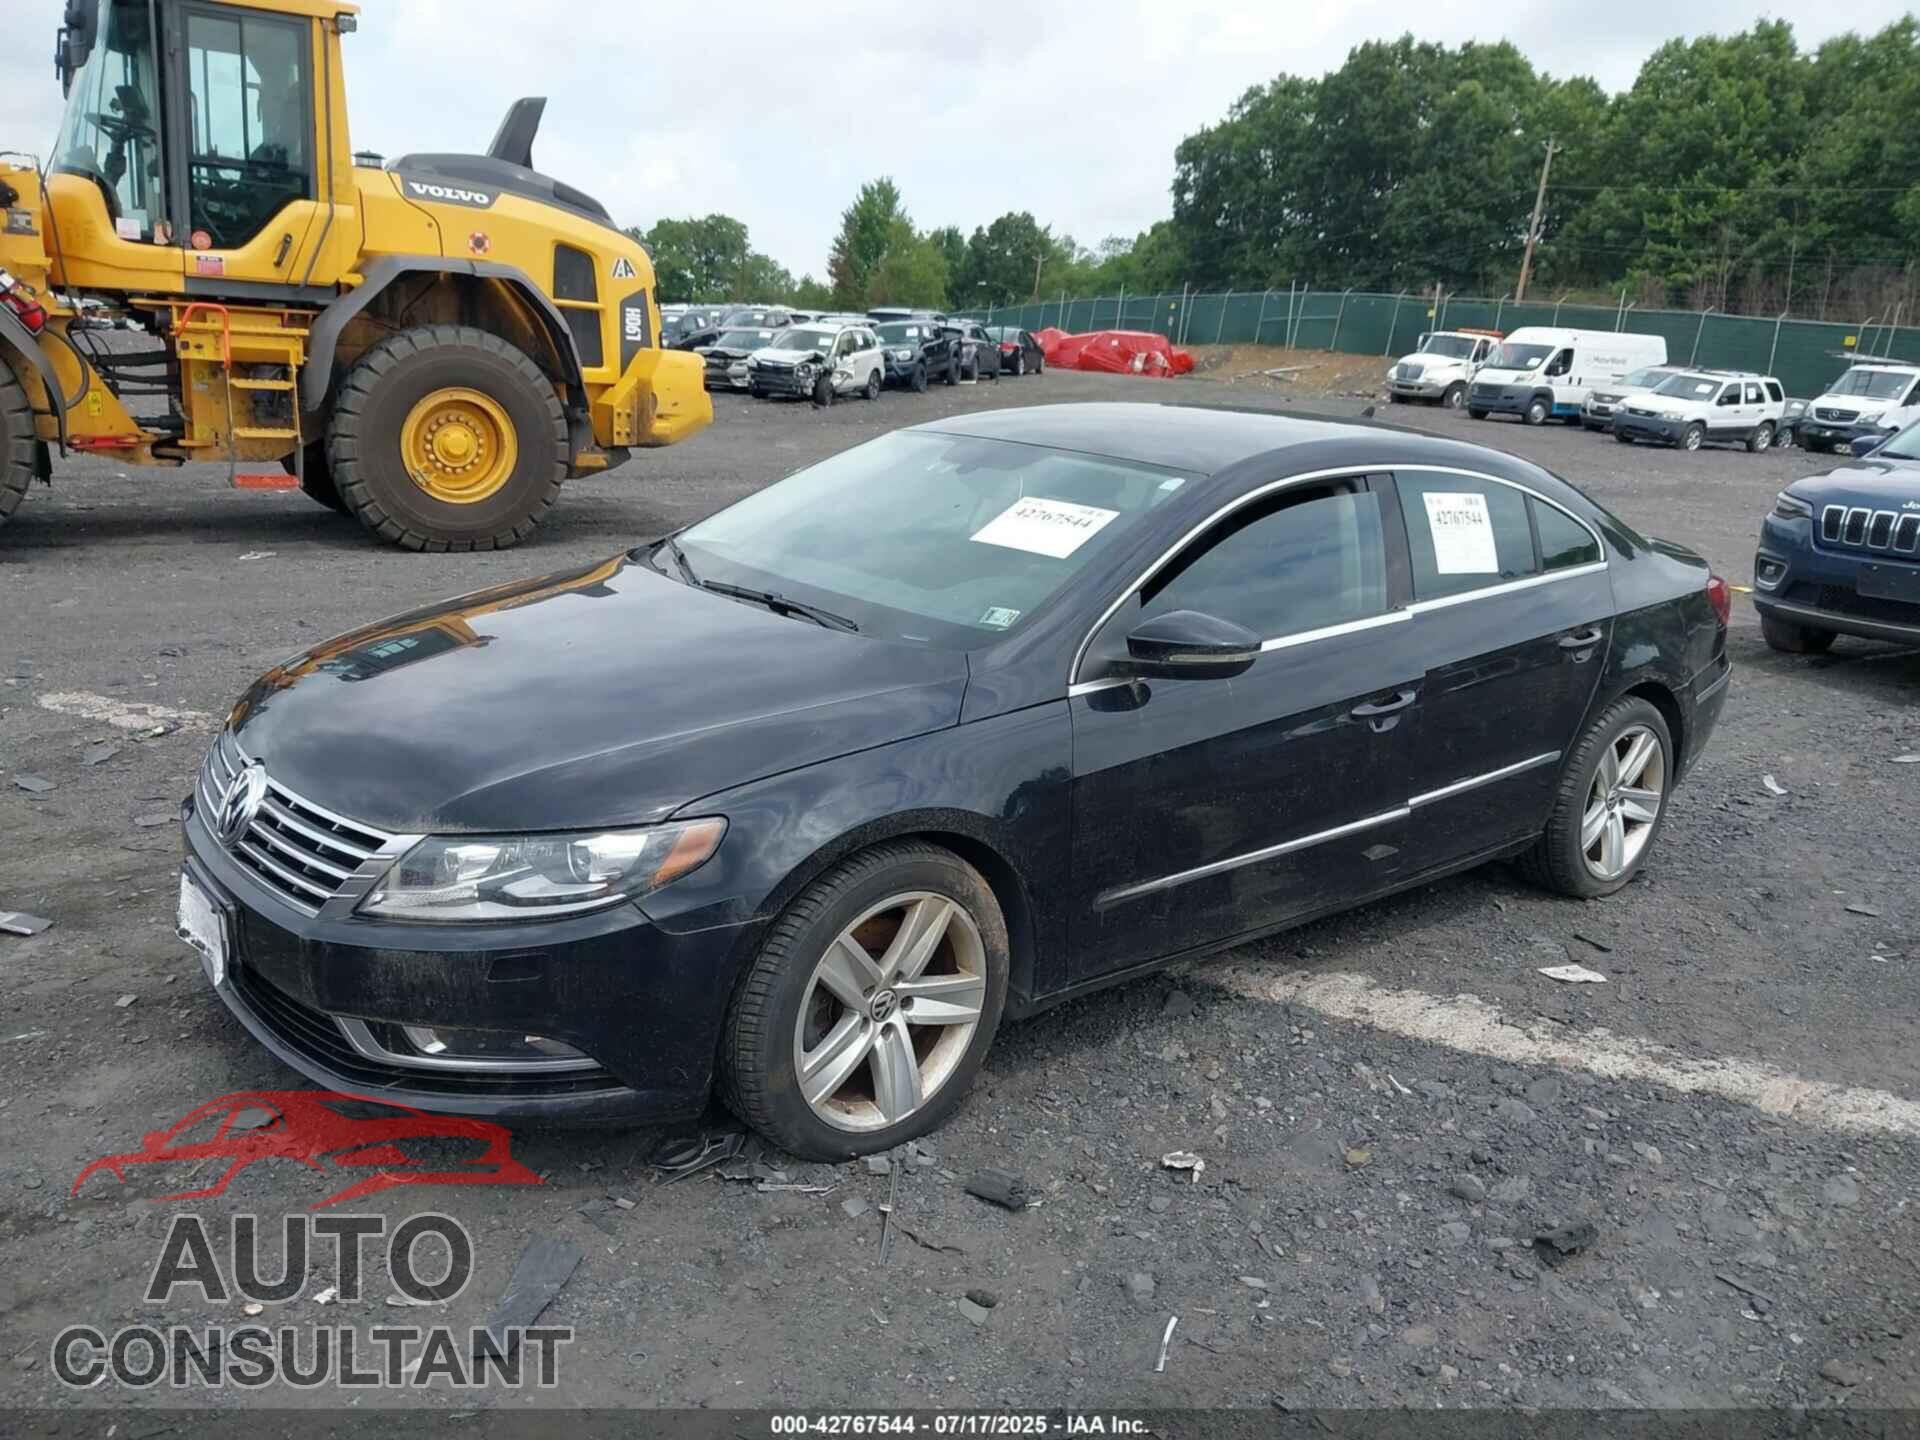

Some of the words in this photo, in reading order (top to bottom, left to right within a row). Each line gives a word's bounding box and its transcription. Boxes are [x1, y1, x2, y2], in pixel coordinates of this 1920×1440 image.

[408, 181, 489, 204] VOLVO
[625, 307, 642, 341] L90H
[1015, 507, 1094, 529] 42767544
[1435, 509, 1484, 527] 42767544
